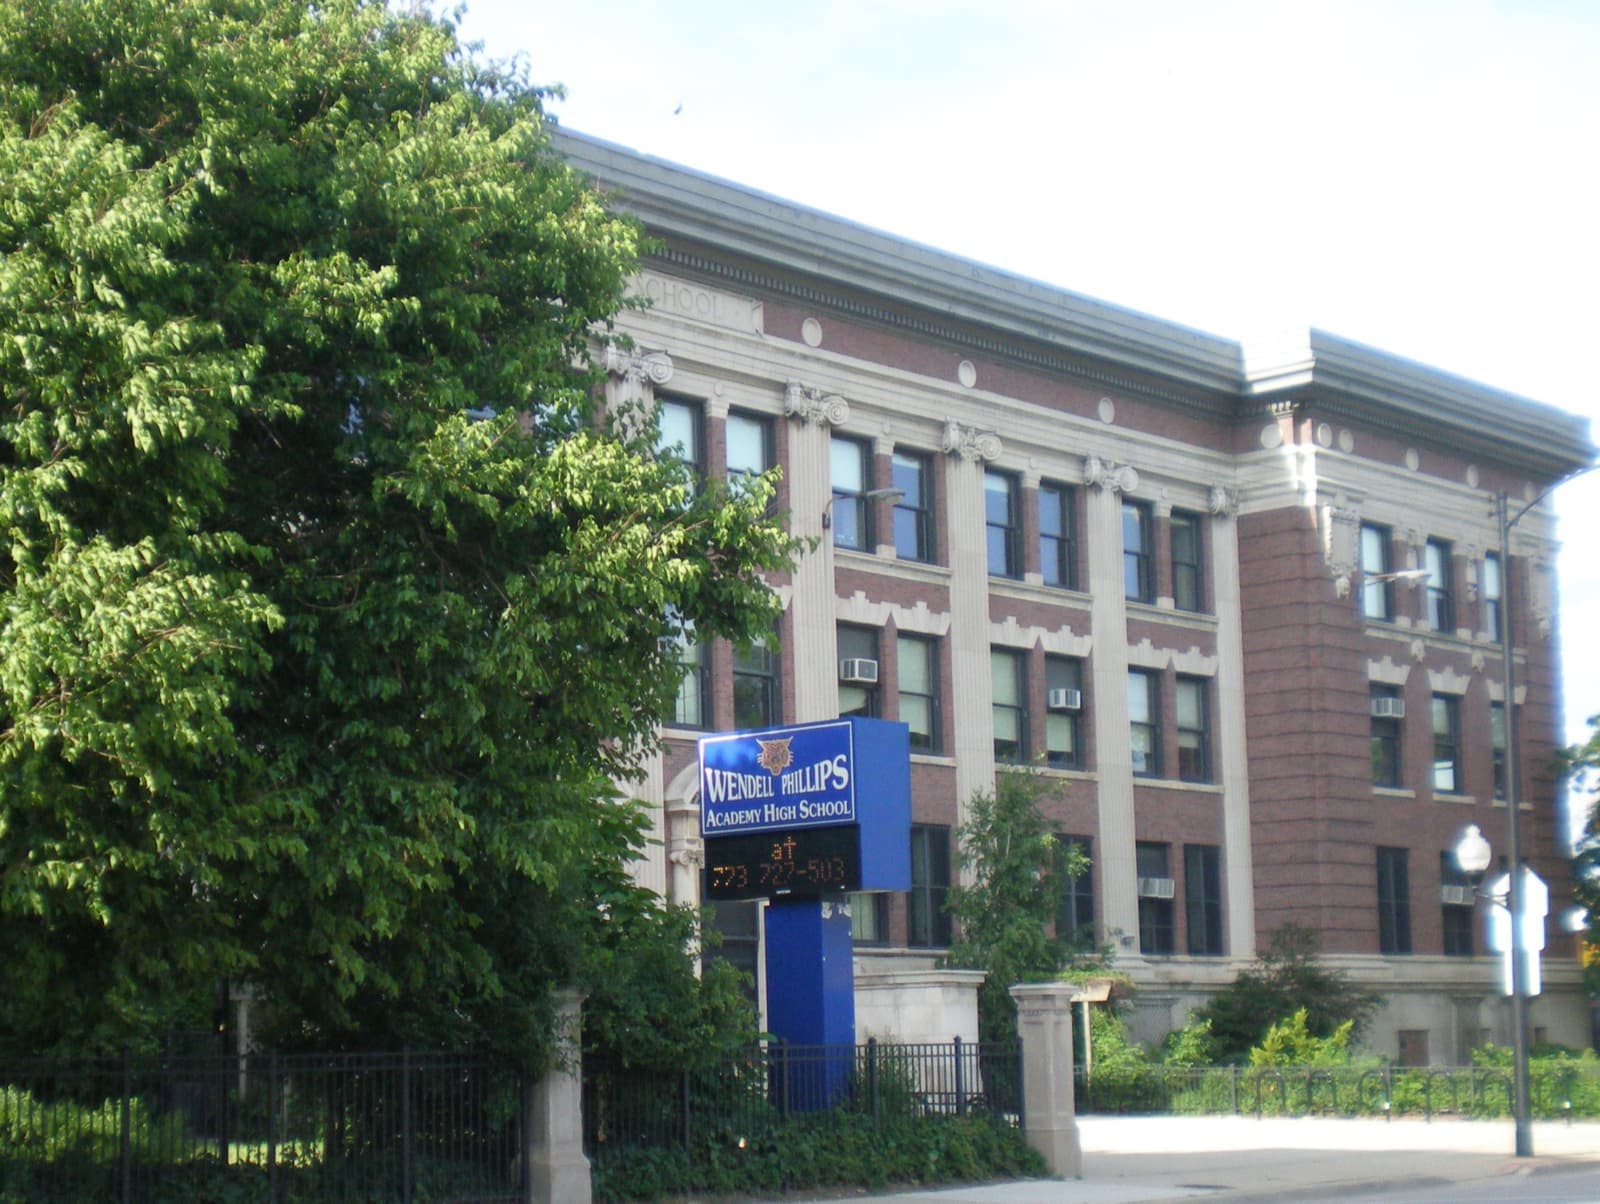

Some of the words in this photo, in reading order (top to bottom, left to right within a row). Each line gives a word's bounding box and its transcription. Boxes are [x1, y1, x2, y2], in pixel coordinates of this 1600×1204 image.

[705, 768, 774, 802] WENDELL
[781, 754, 849, 796] PHILLIPS
[706, 809, 762, 828] ACADEMY
[764, 804, 796, 822] HIGH
[800, 799, 851, 819] SCHOOL
